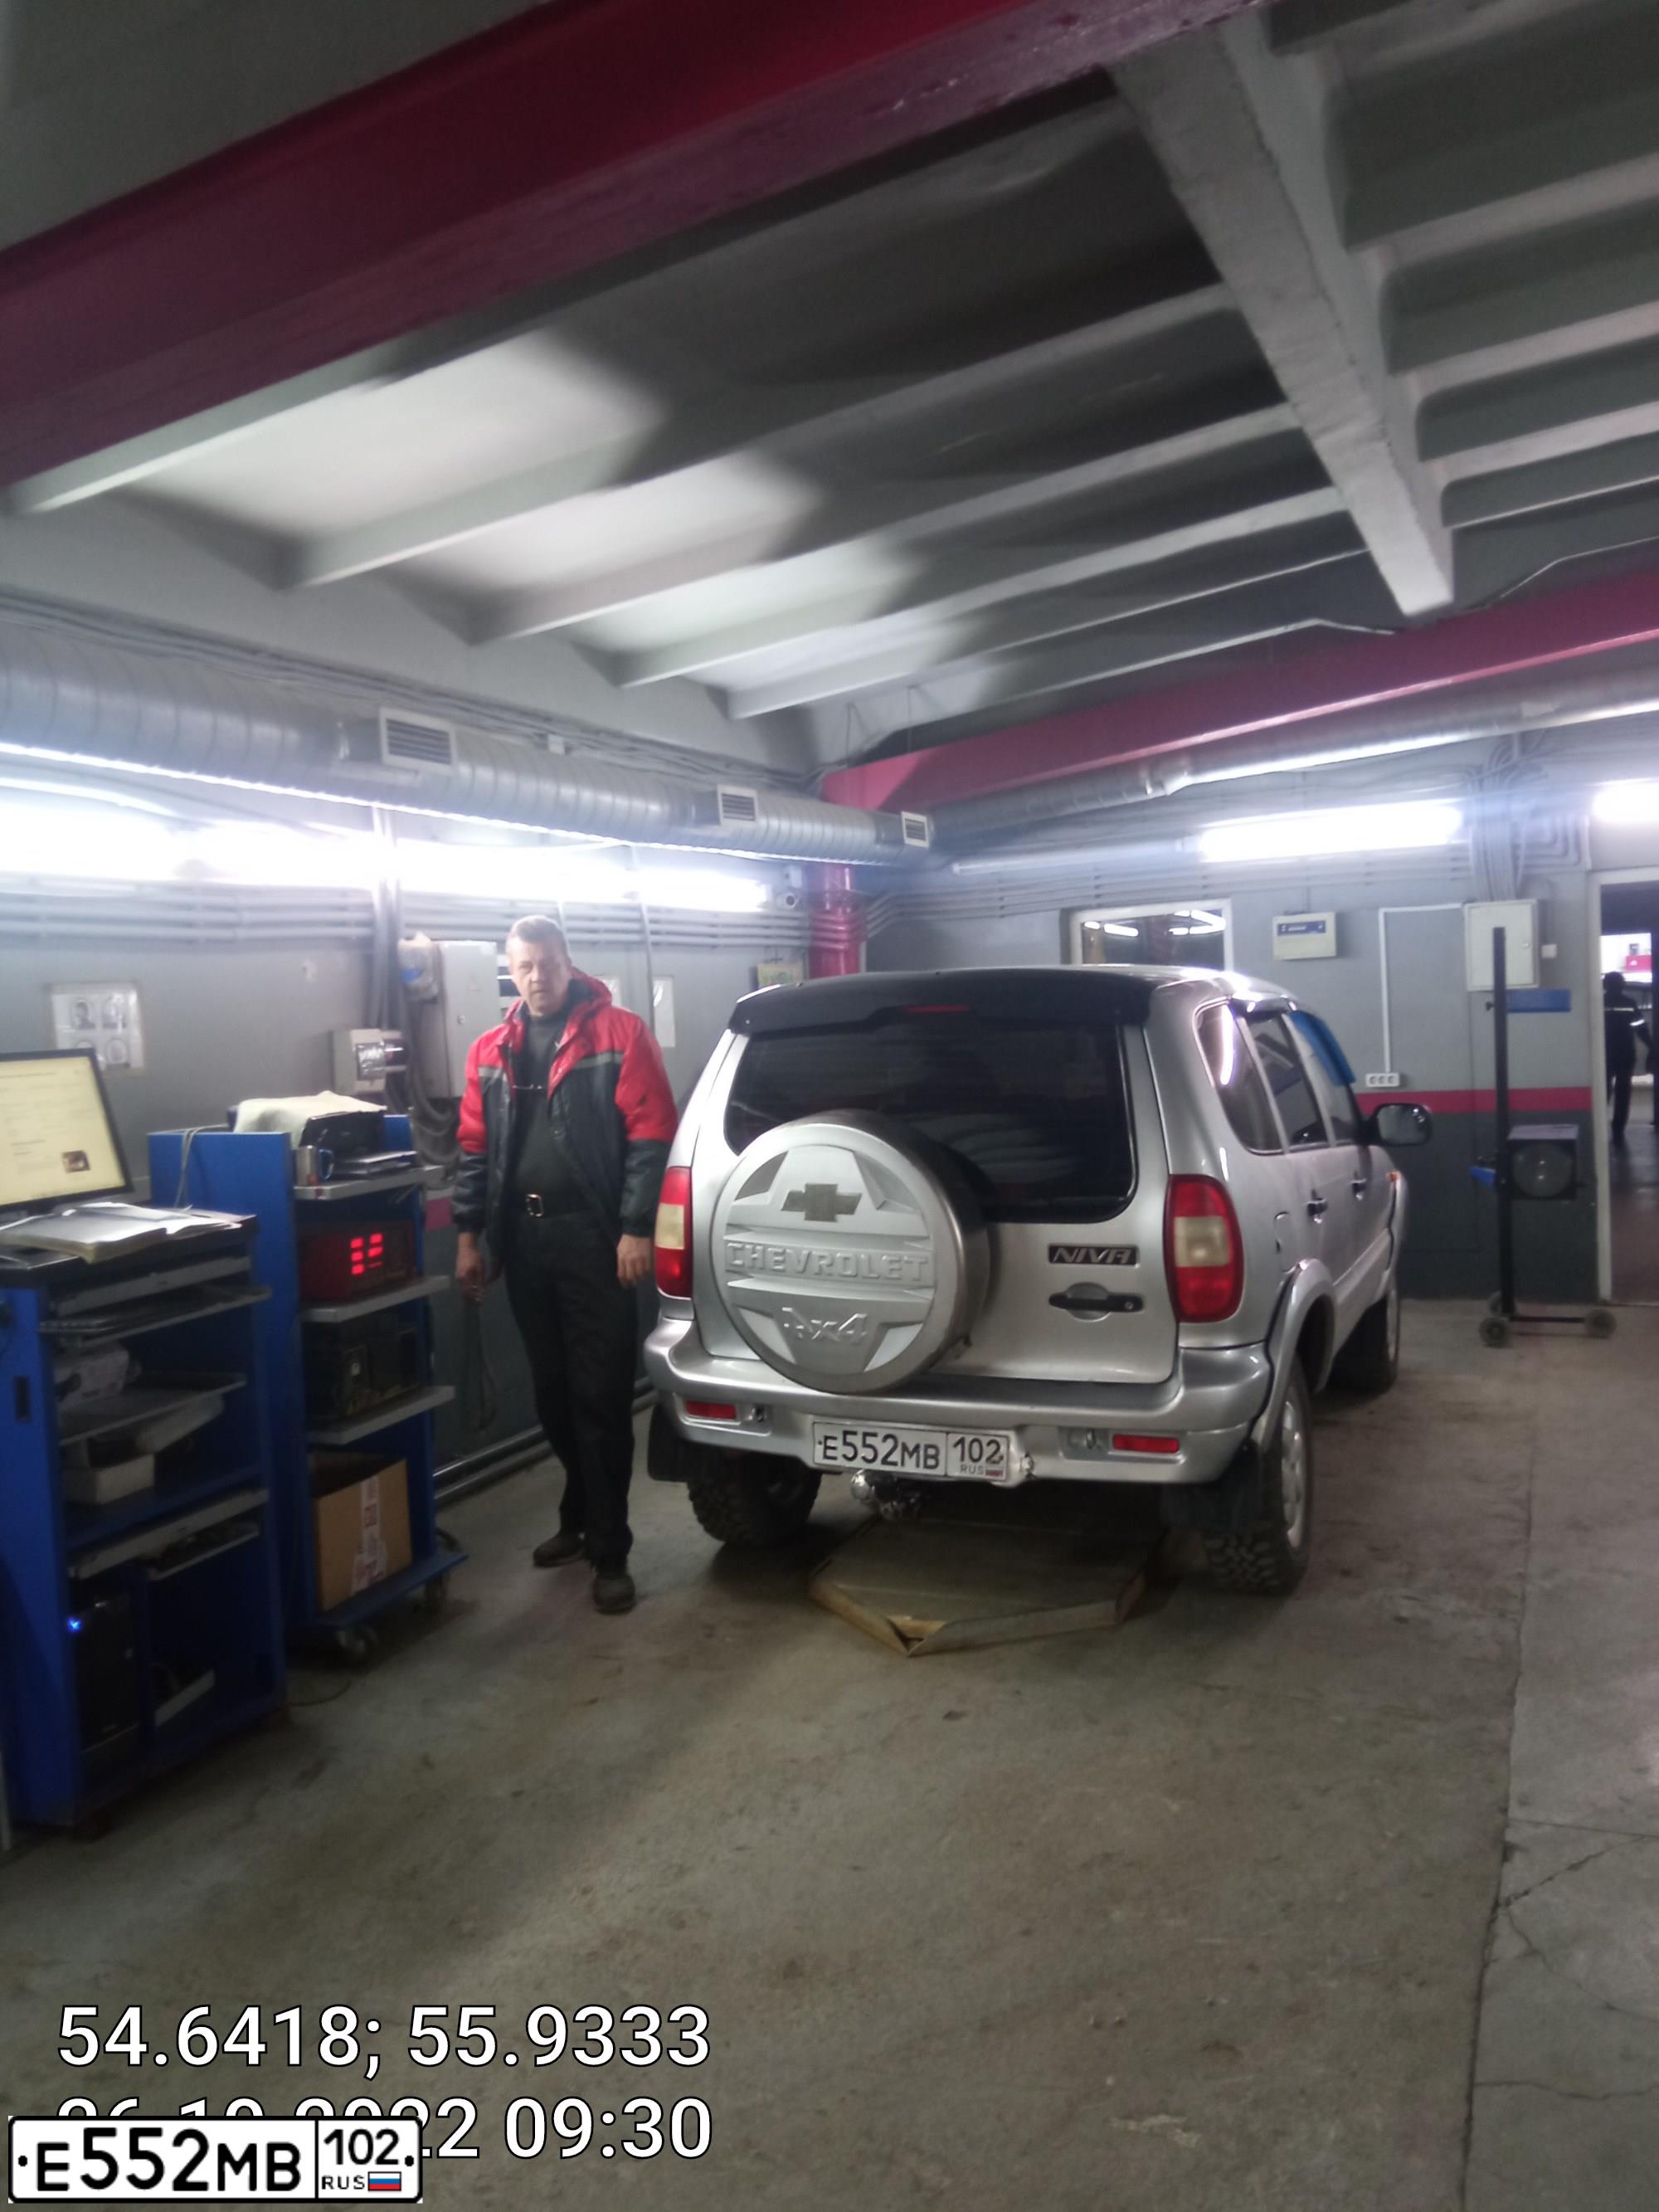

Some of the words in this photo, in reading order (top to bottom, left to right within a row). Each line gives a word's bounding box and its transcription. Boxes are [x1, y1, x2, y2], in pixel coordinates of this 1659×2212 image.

[727, 1242, 927, 1281] CHEVROLET
[1053, 1247, 1132, 1264] NIVA
[953, 1436, 1004, 1464] 102
[960, 1464, 984, 1475] RUS
